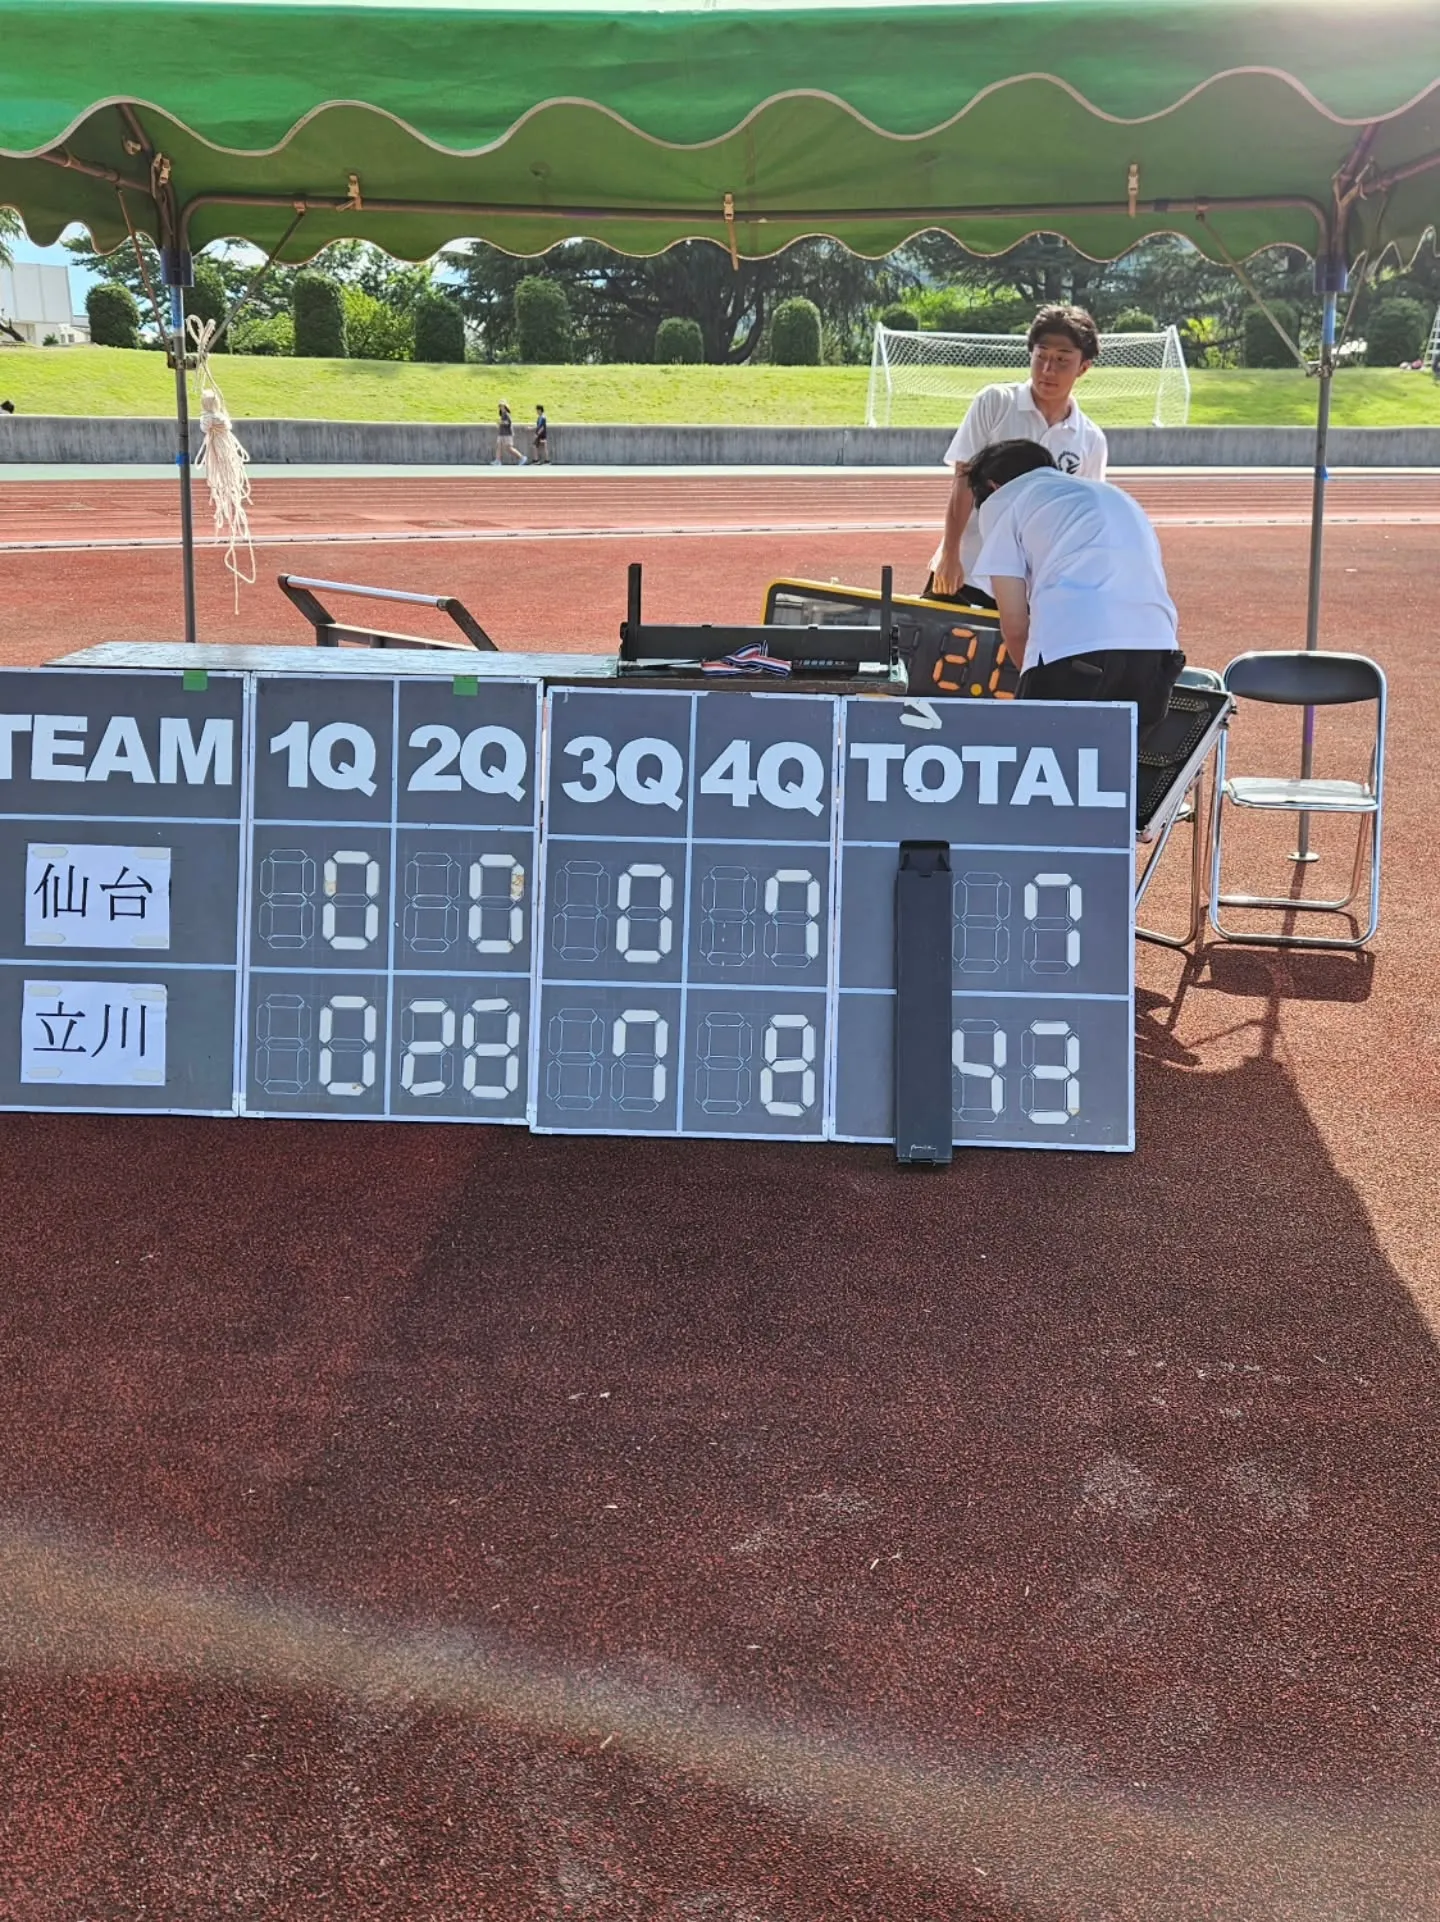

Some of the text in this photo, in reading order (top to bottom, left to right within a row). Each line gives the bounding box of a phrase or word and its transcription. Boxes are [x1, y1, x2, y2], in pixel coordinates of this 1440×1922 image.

[0, 714, 1127, 817] TEAM 1Q 2Q 3Q 4Q TOTAL
[33, 850, 1082, 967] 仙台 0 0 0 7 7
[33, 995, 1080, 1125] 立川 0 28 7 8 43
